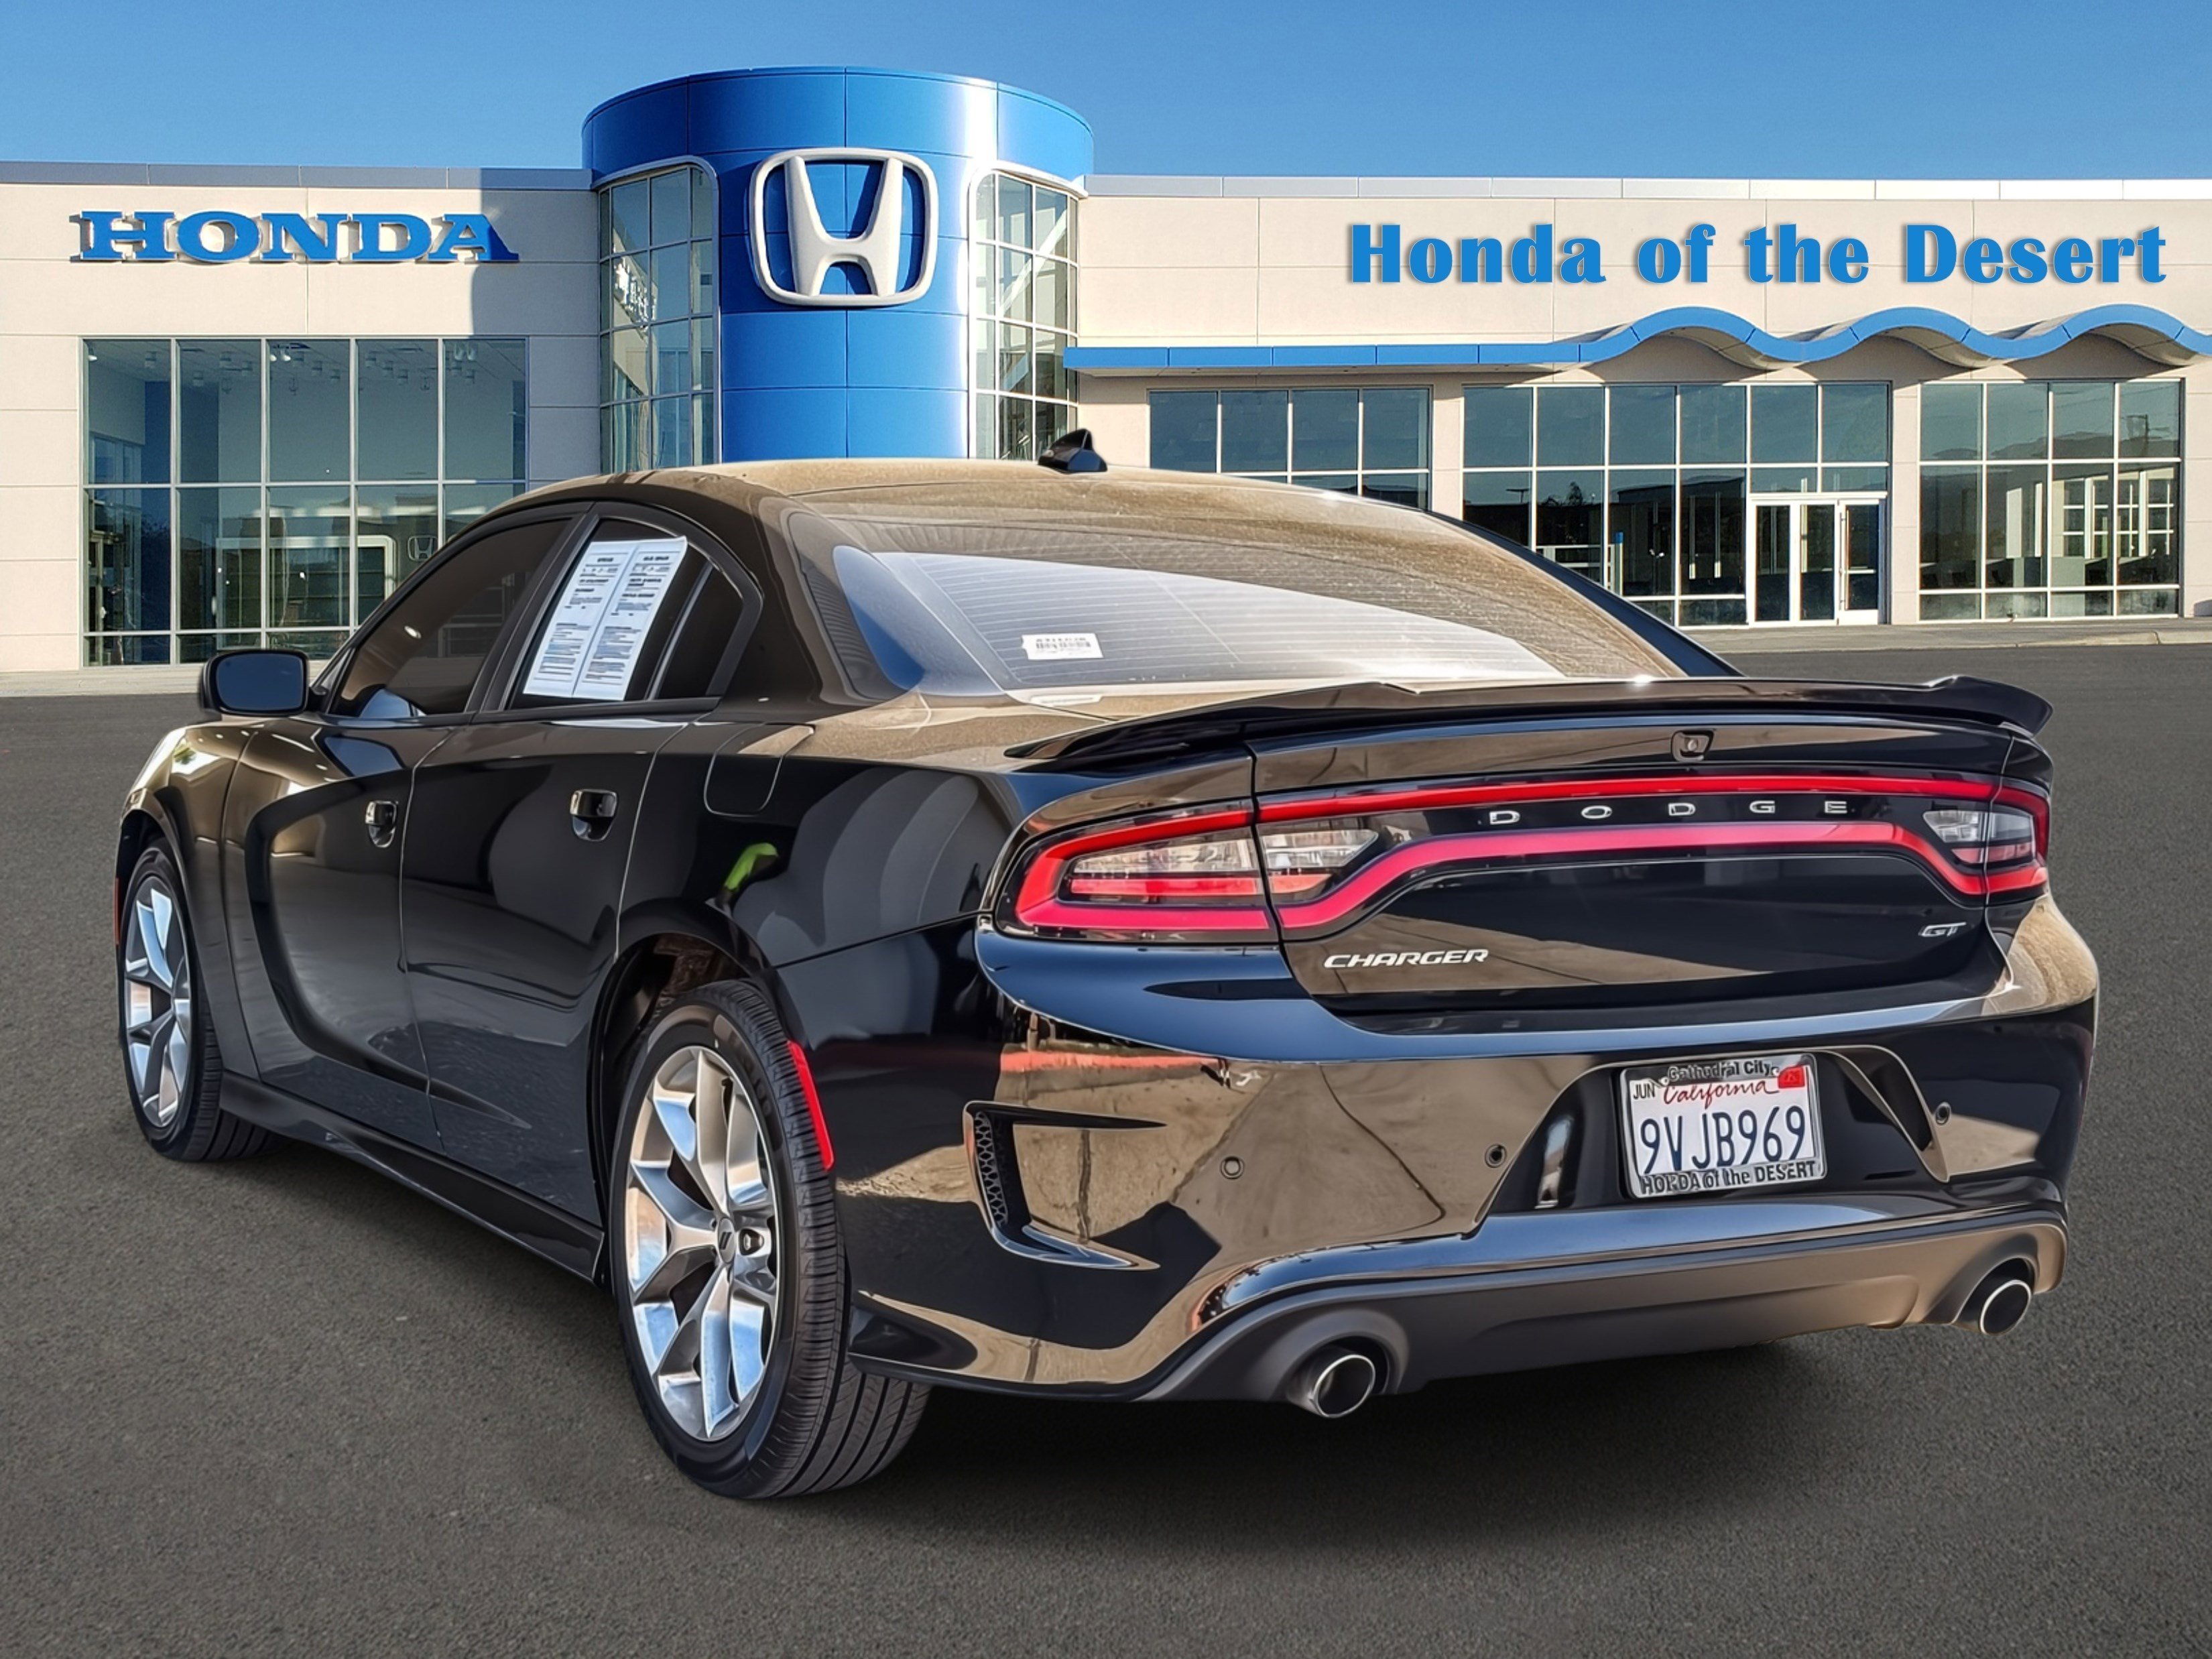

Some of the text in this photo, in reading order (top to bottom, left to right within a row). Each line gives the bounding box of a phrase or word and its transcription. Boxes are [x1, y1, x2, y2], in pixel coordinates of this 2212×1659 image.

[72, 210, 519, 262] HONDA
[1351, 223, 2167, 284] Honda of the Desert
[1489, 800, 1848, 825] DODGE
[1918, 921, 1967, 938] GT
[1323, 948, 1489, 968] CHARGER
[1744, 1059, 1771, 1076] City
[1632, 1083, 1656, 1100] JUN
[1663, 1079, 1780, 1109] California
[1640, 1105, 1806, 1174] 9VJB969
[1641, 1160, 1816, 1195] HONDA of the DESERT
